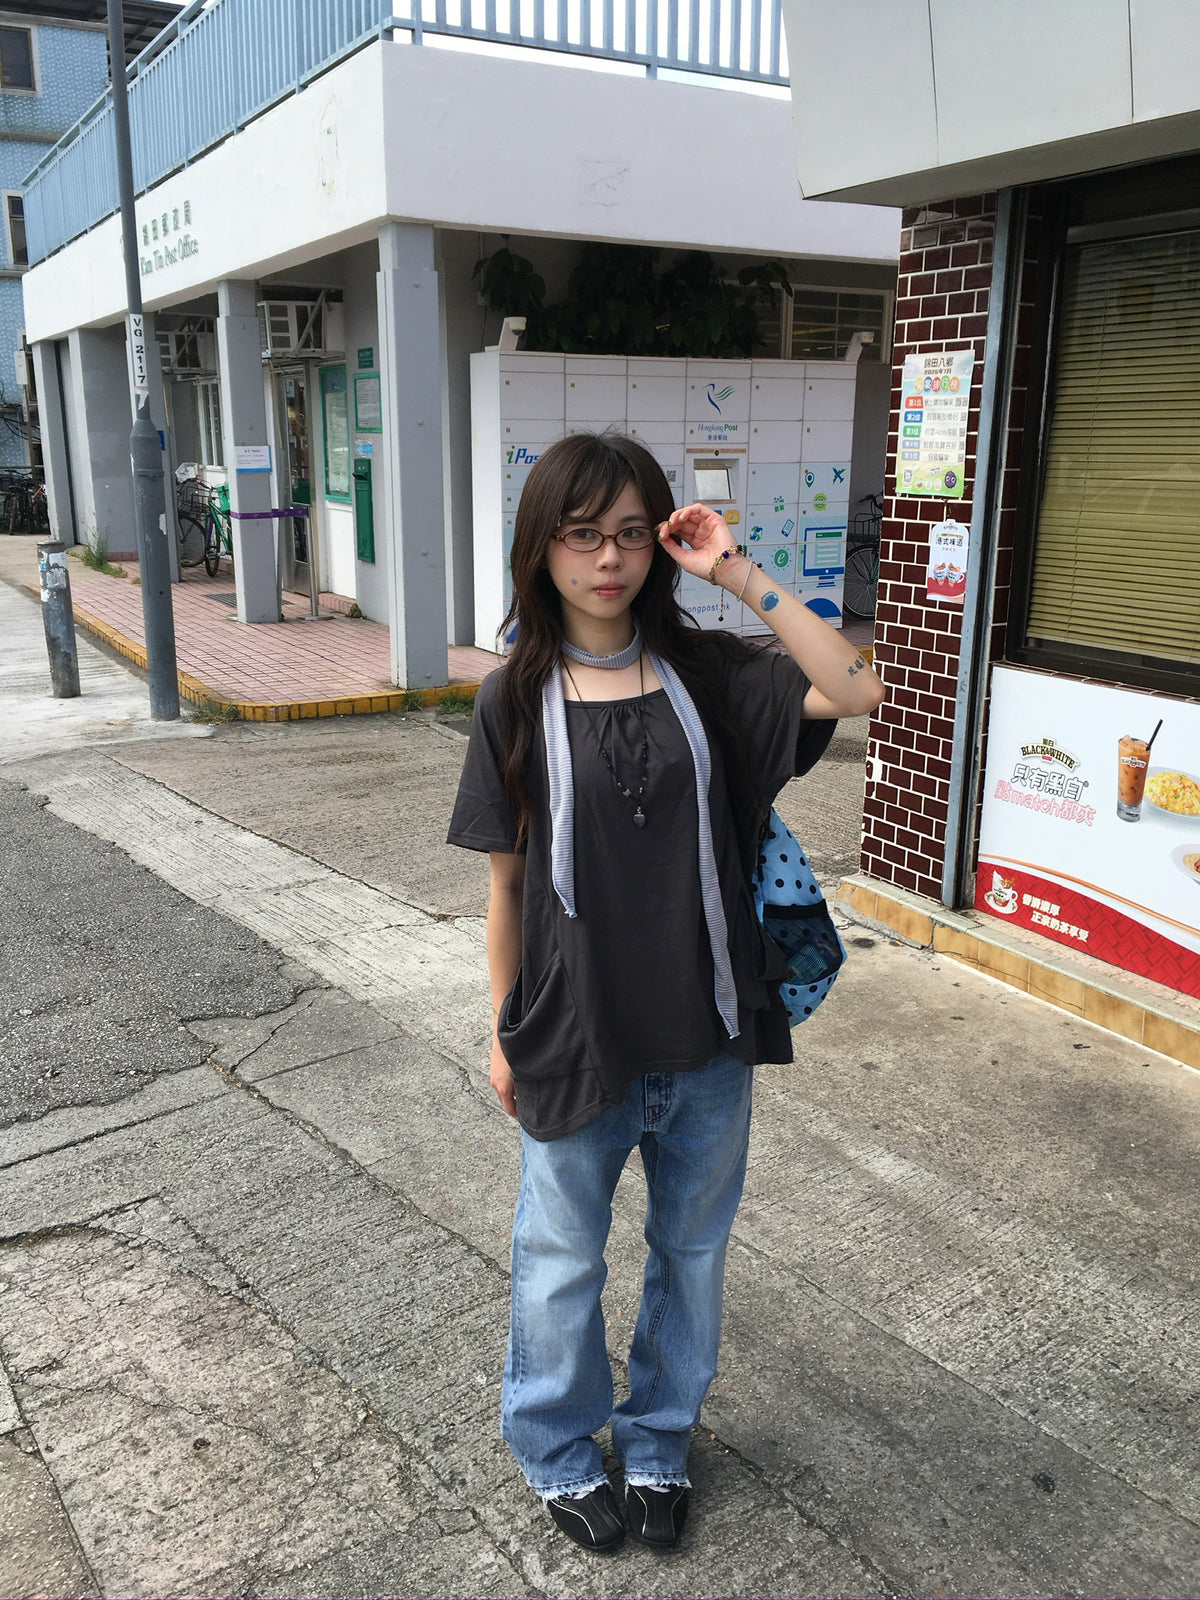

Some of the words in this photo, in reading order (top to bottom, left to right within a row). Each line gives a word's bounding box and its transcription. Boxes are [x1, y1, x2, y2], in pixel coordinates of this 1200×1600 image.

[153, 249, 164, 271] Tin
[164, 245, 178, 267] Post
[178, 234, 199, 261] Office
[133, 318, 143, 337] VG
[135, 345, 146, 384] 2117
[723, 423, 738, 431] Post
[936, 537, 963, 546] 港式味道
[1030, 910, 1090, 943] 正宗奶茶享受
